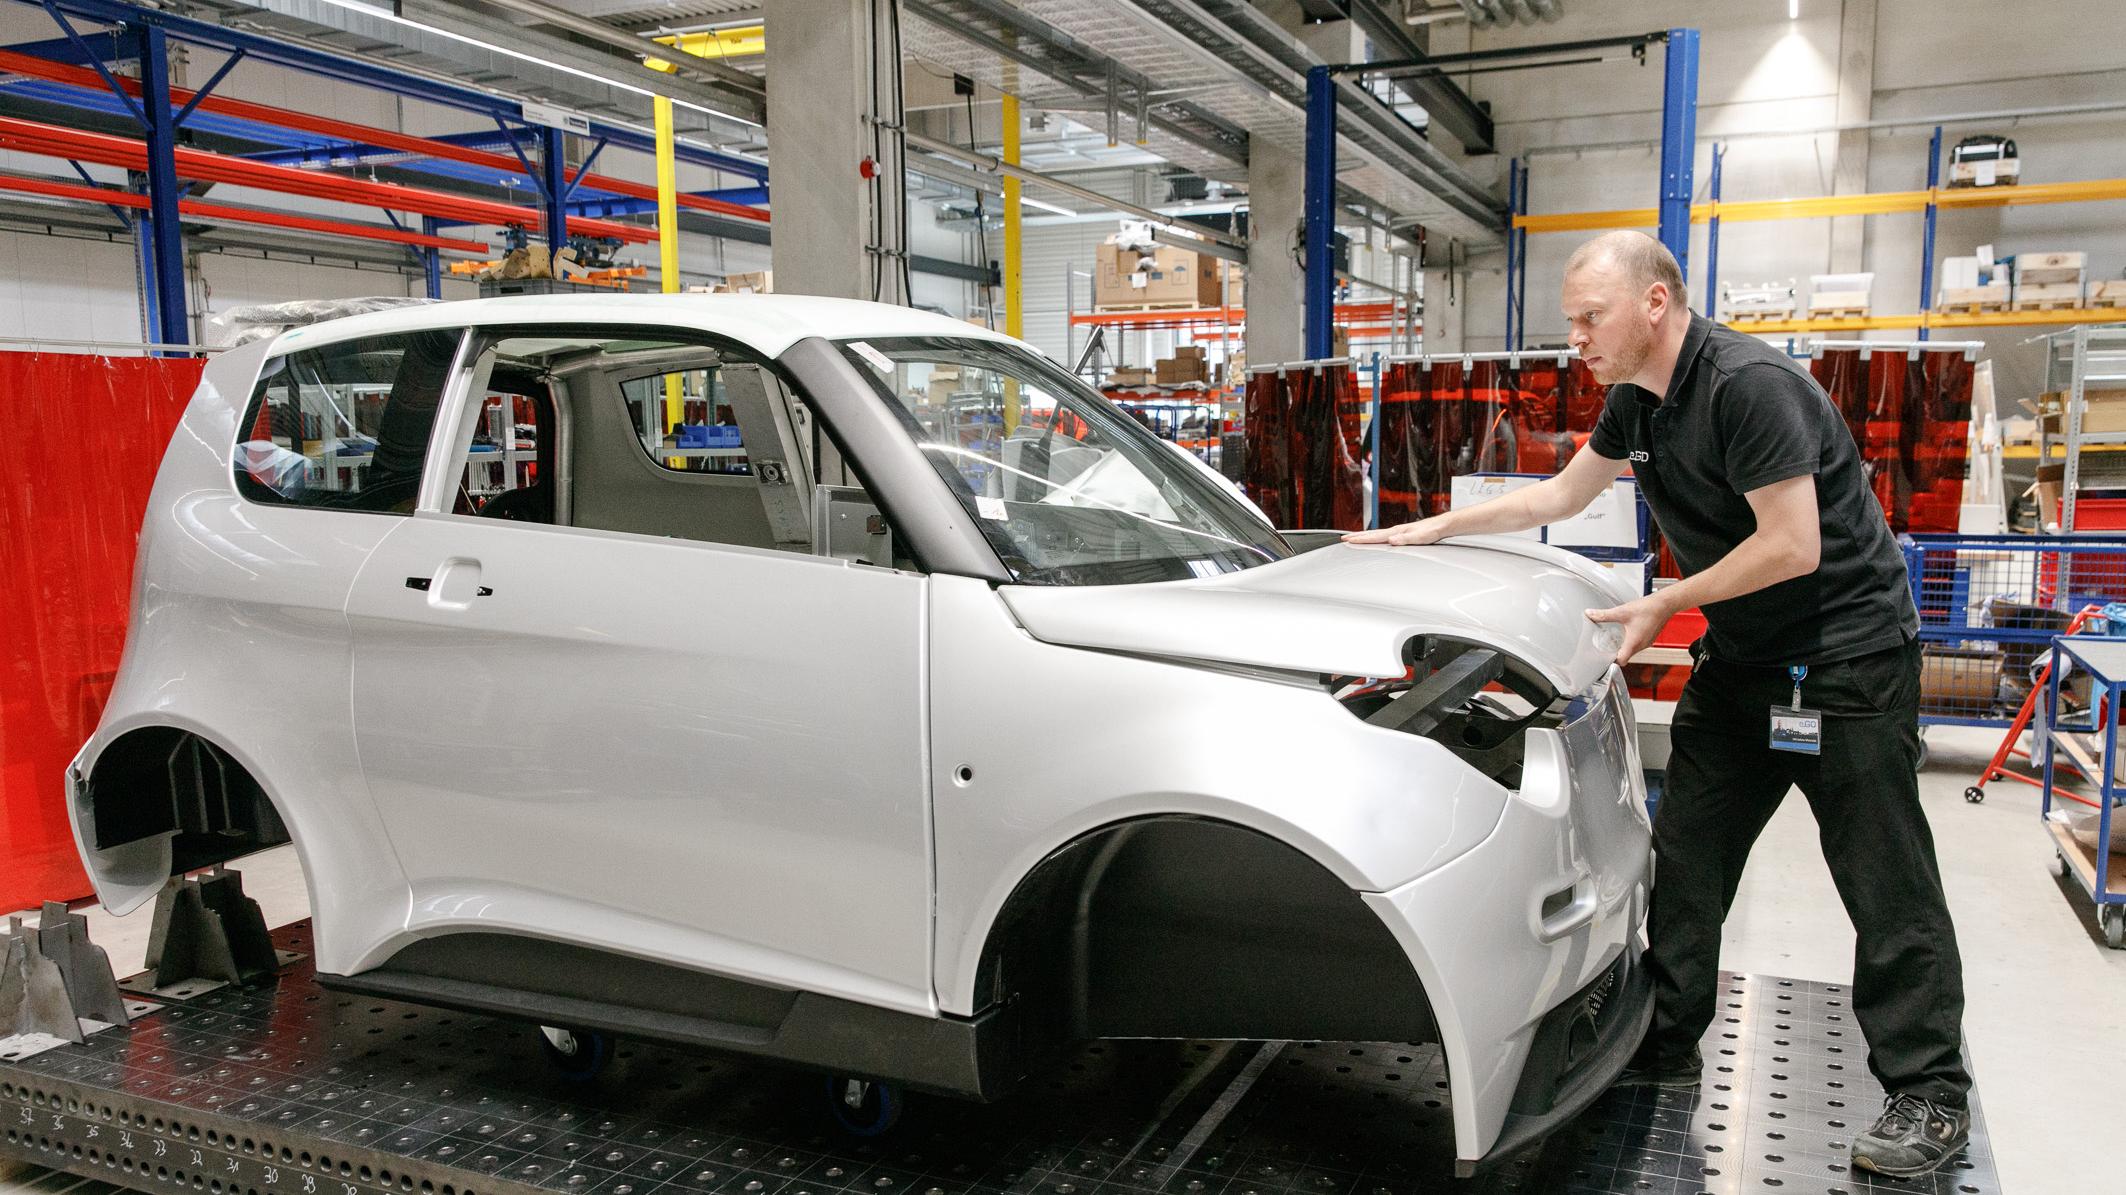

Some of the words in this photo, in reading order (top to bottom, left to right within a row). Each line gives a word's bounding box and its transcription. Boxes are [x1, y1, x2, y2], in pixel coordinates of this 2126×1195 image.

[20, 1106, 35, 1126] 37
[86, 1124, 100, 1138] 35
[119, 1130, 135, 1149] 34
[153, 1139, 167, 1157] 33
[225, 1157, 240, 1174] 31
[263, 1165, 279, 1184] 30
